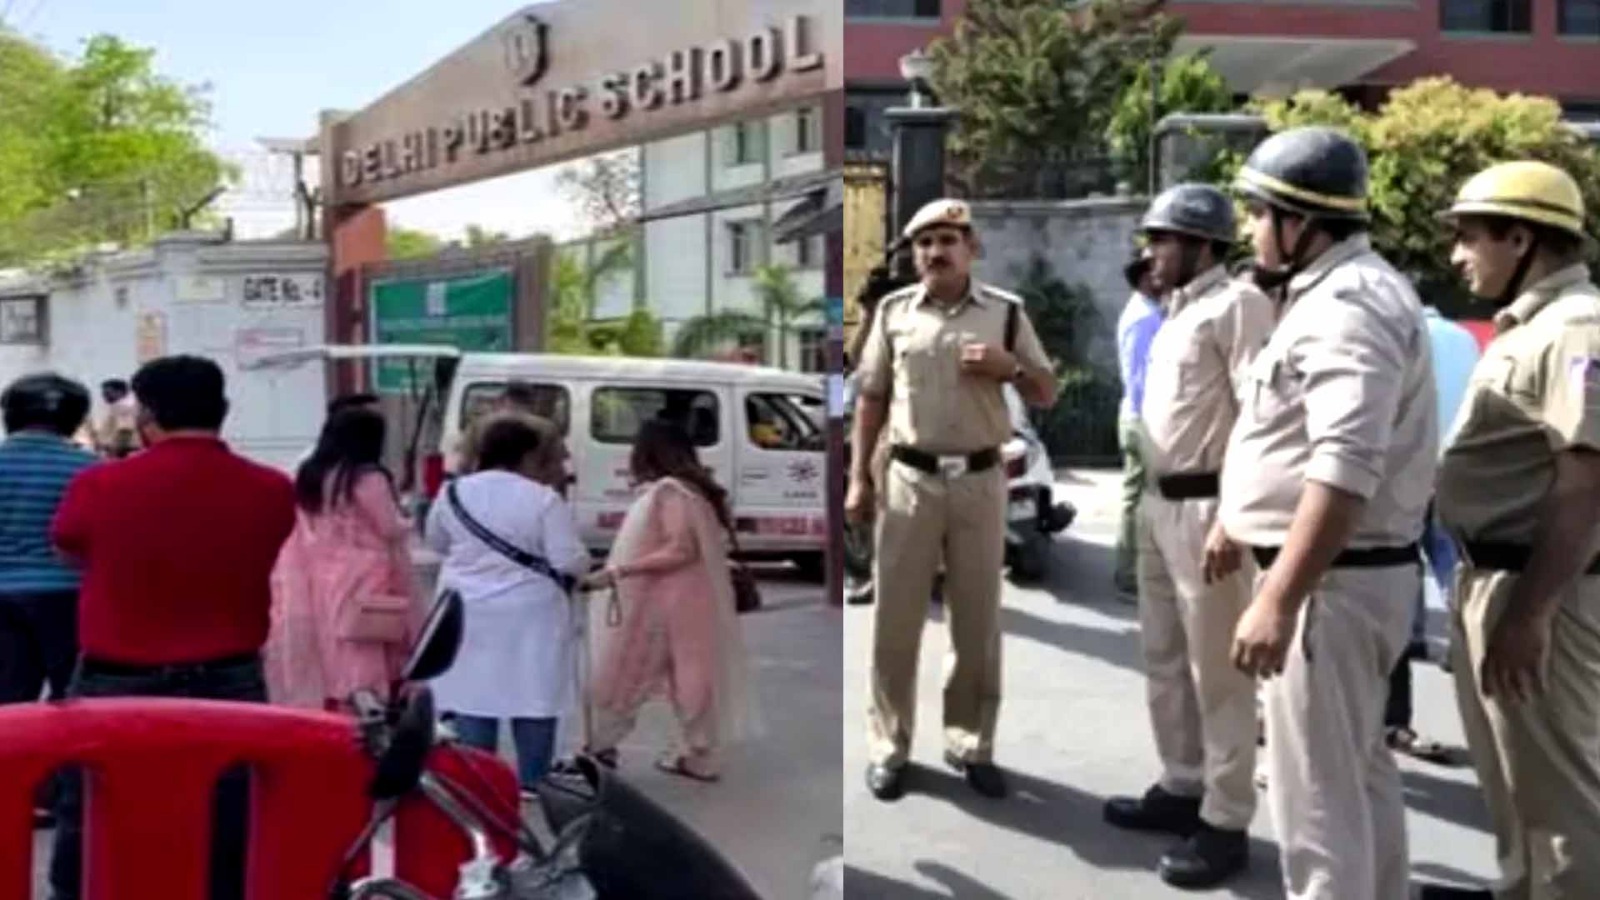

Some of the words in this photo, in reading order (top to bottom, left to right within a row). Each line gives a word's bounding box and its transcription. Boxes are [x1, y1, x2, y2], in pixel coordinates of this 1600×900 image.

[339, 127, 438, 188] DELHI
[440, 86, 590, 164] PUBLIC
[601, 15, 824, 122] SCHOOL
[243, 277, 279, 302] GATE
